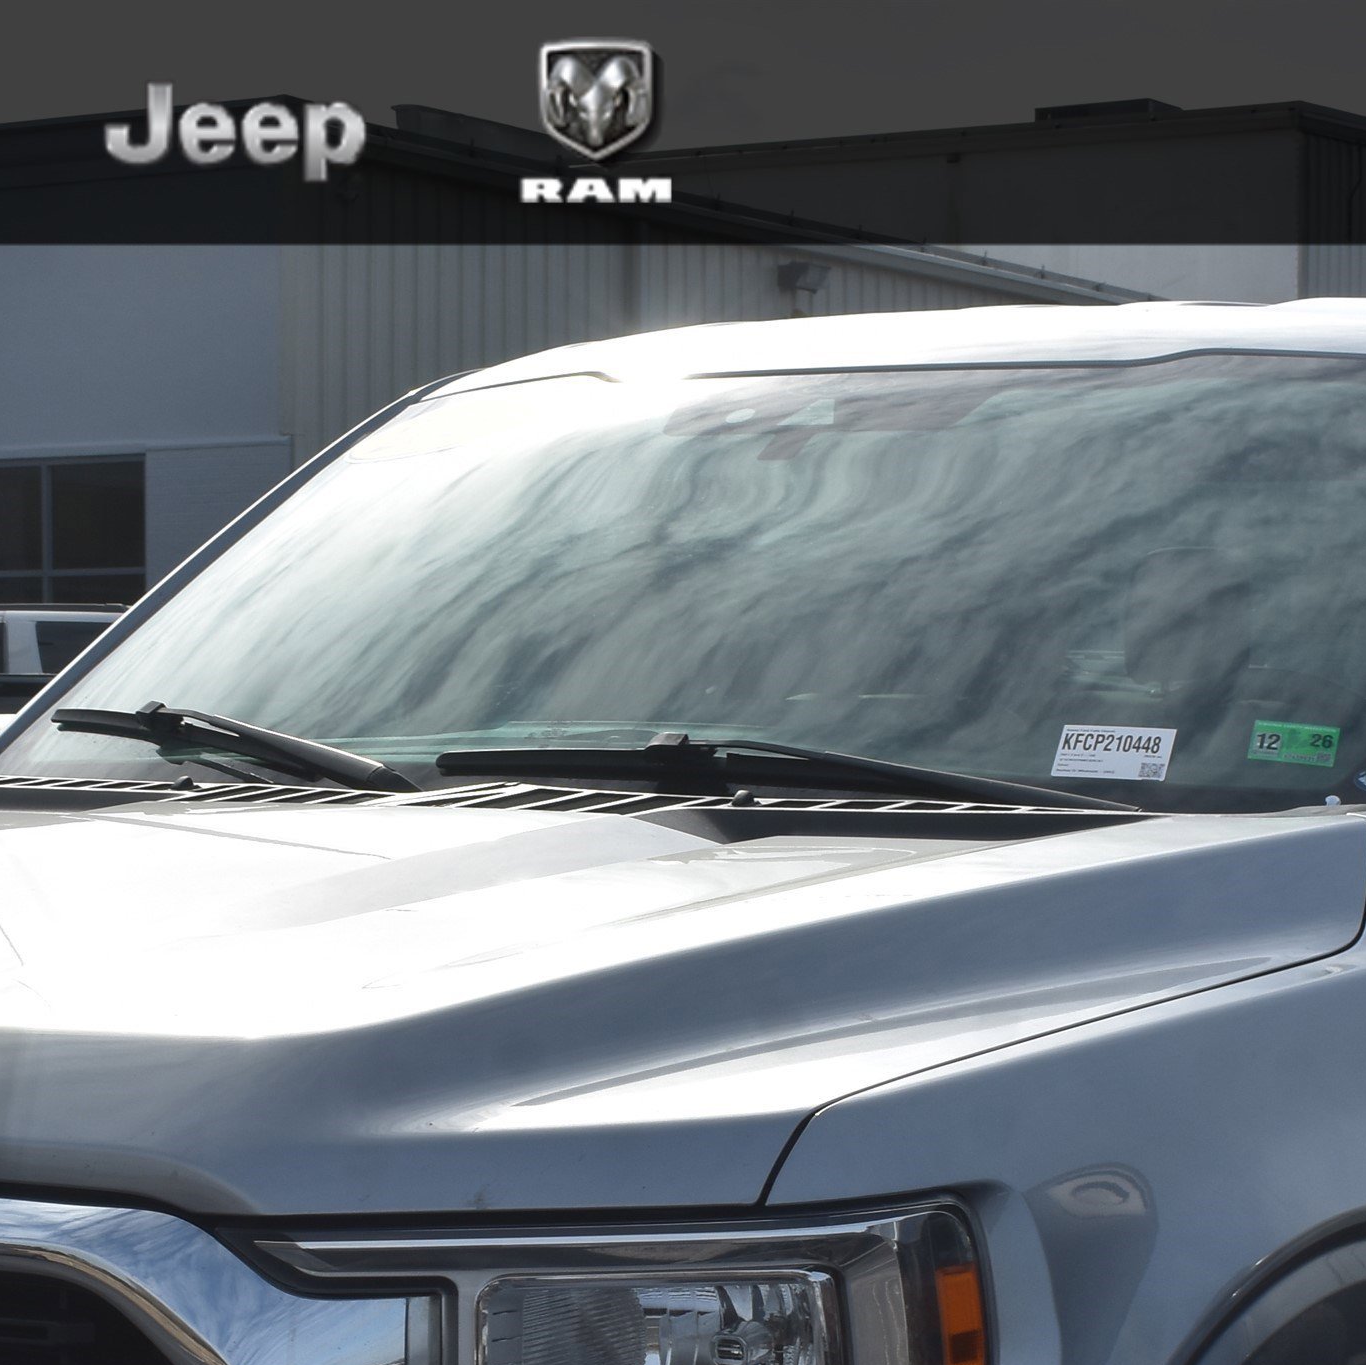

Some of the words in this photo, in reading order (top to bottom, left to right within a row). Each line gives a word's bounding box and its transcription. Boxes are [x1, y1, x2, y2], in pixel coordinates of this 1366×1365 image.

[1062, 733, 1161, 754] KFCP210448
[1256, 733, 1281, 751] 12
[1310, 733, 1334, 749] 26
